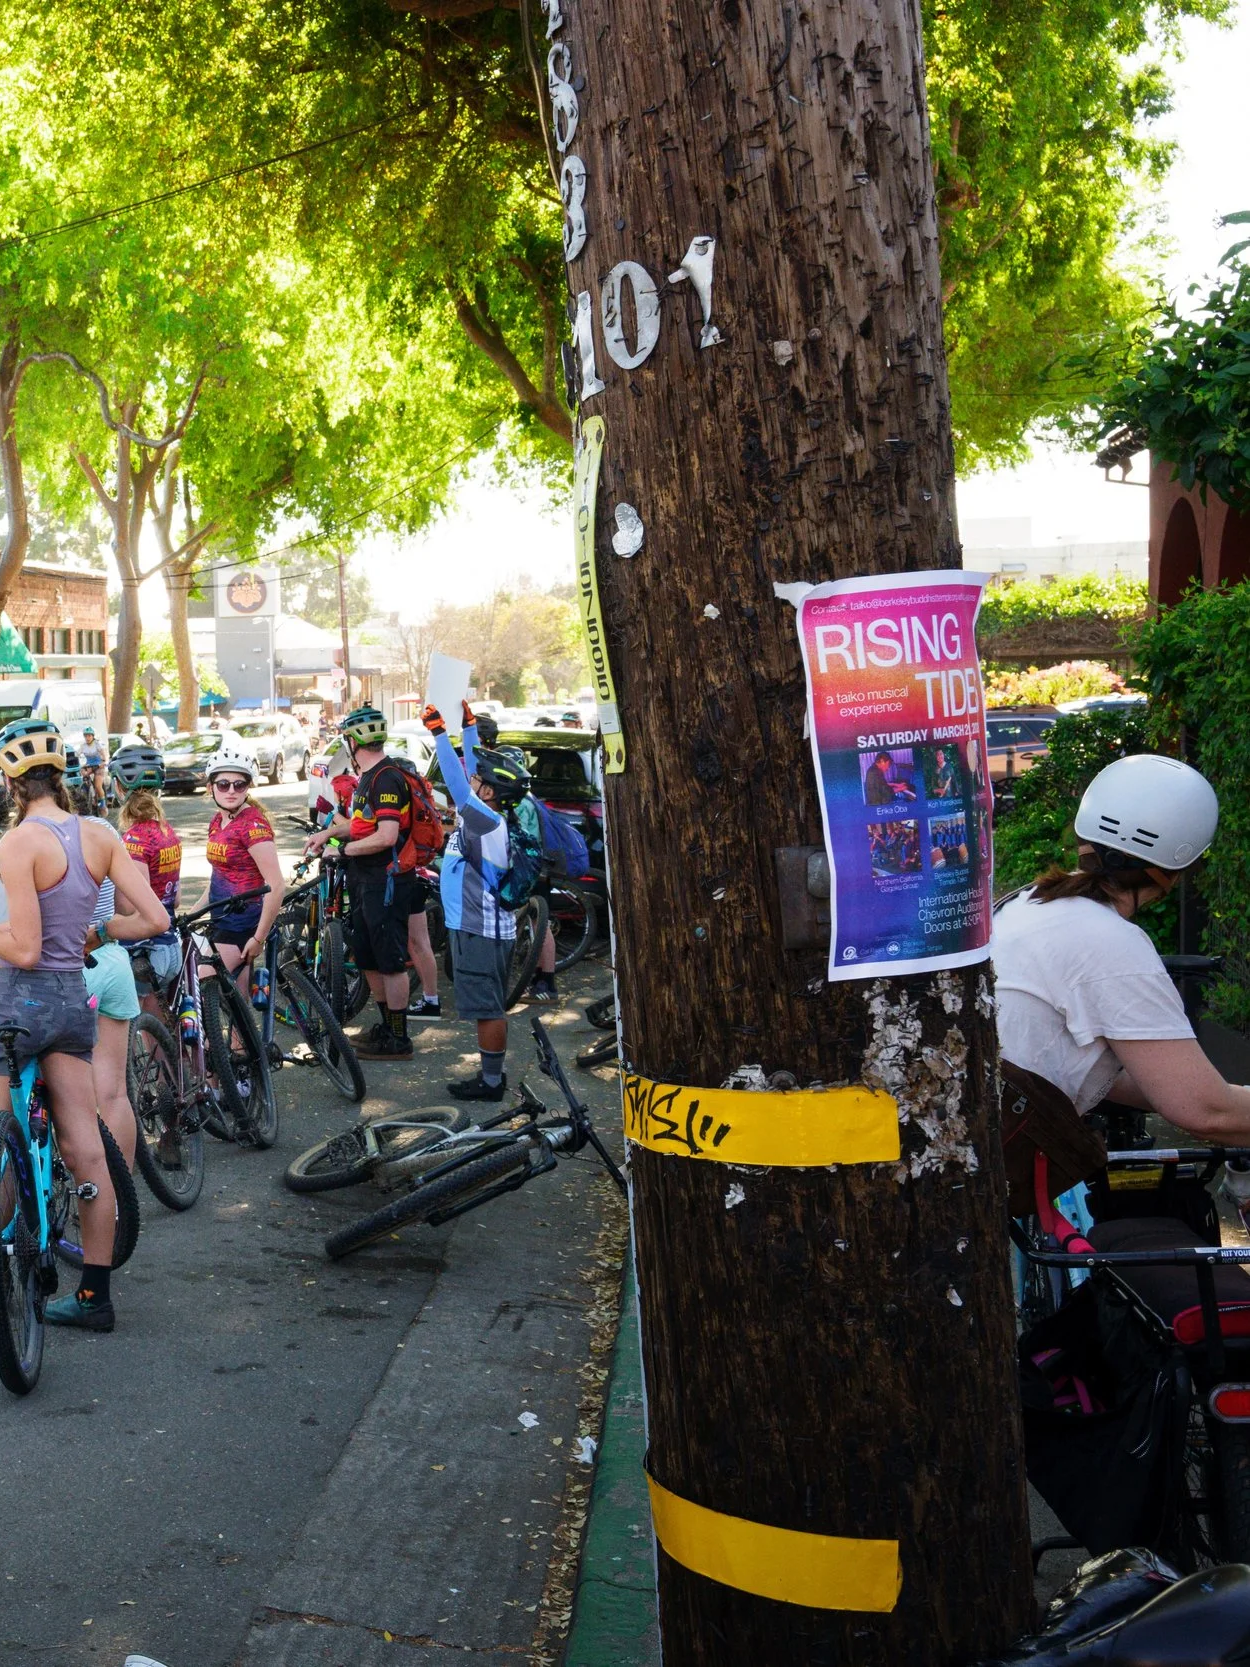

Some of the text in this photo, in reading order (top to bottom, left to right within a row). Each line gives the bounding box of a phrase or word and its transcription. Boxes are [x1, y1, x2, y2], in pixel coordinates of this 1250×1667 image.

[571, 236, 725, 400] 101
[814, 613, 962, 674] RISING
[826, 685, 909, 706] a taiko musical
[915, 668, 979, 720] TIDE
[840, 701, 903, 718] experience
[857, 729, 928, 748] SATURDAY
[933, 724, 965, 740] MARCH
[379, 793, 399, 804] COACH
[877, 805, 908, 816] Erika Oba
[874, 877, 899, 886] Northern
[918, 889, 967, 908] International
[918, 907, 956, 921] Chevron
[924, 921, 951, 934] Doors
[953, 918, 961, 930] at
